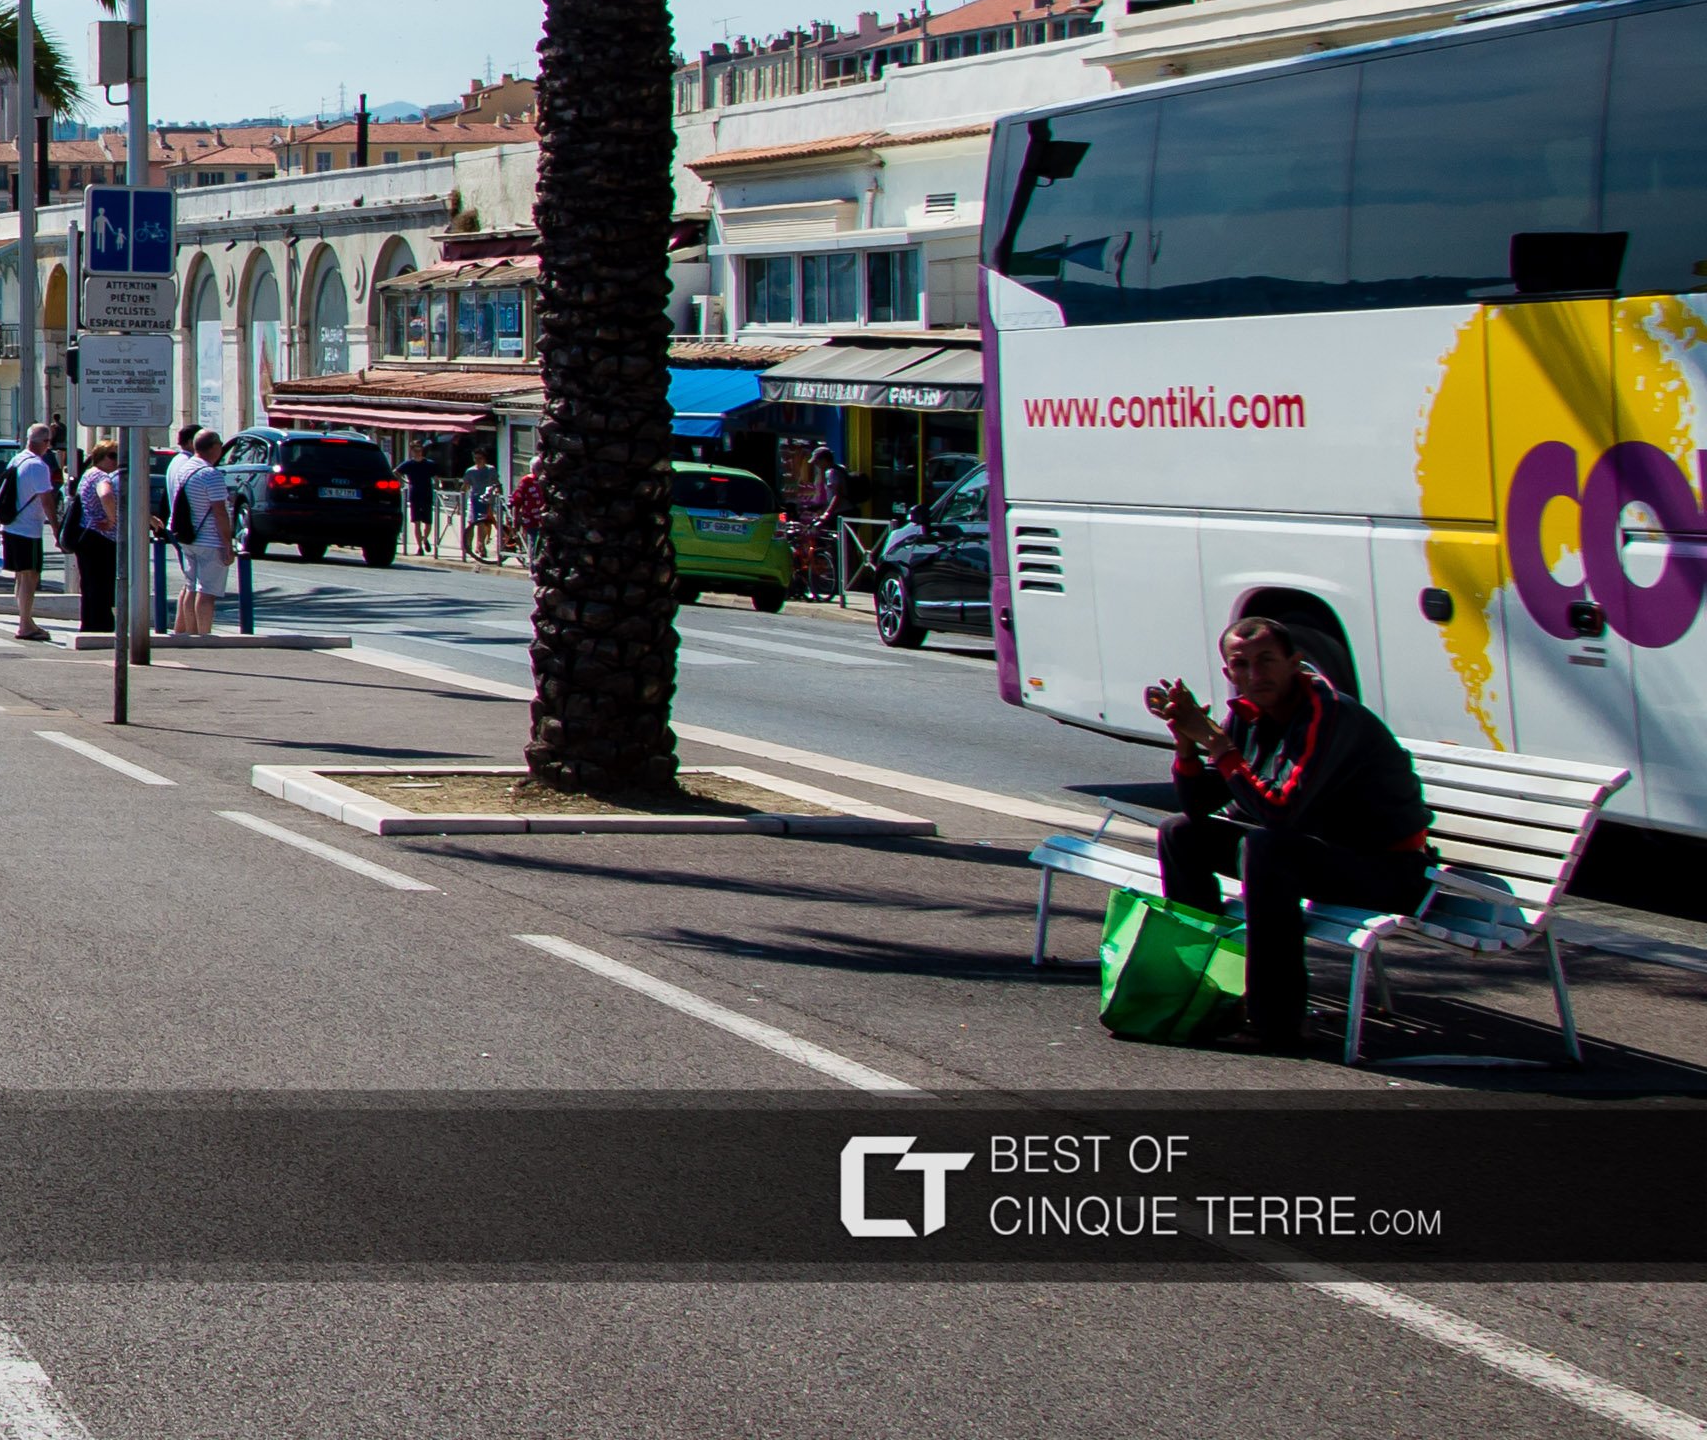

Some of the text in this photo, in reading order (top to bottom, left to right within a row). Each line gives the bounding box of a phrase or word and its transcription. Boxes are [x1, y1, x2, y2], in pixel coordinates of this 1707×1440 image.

[105, 281, 158, 290] ATTENTION
[110, 292, 151, 304] PIÉTONS
[105, 306, 157, 316] CYCLISTES
[89, 318, 172, 330] ESPACE PARTAGÉ
[85, 368, 101, 377] Des
[158, 377, 167, 386] et
[107, 385, 116, 394] la
[794, 381, 869, 401] RESTAURANT
[1022, 385, 1306, 429] www.contiki.com
[1504, 440, 1707, 649] co
